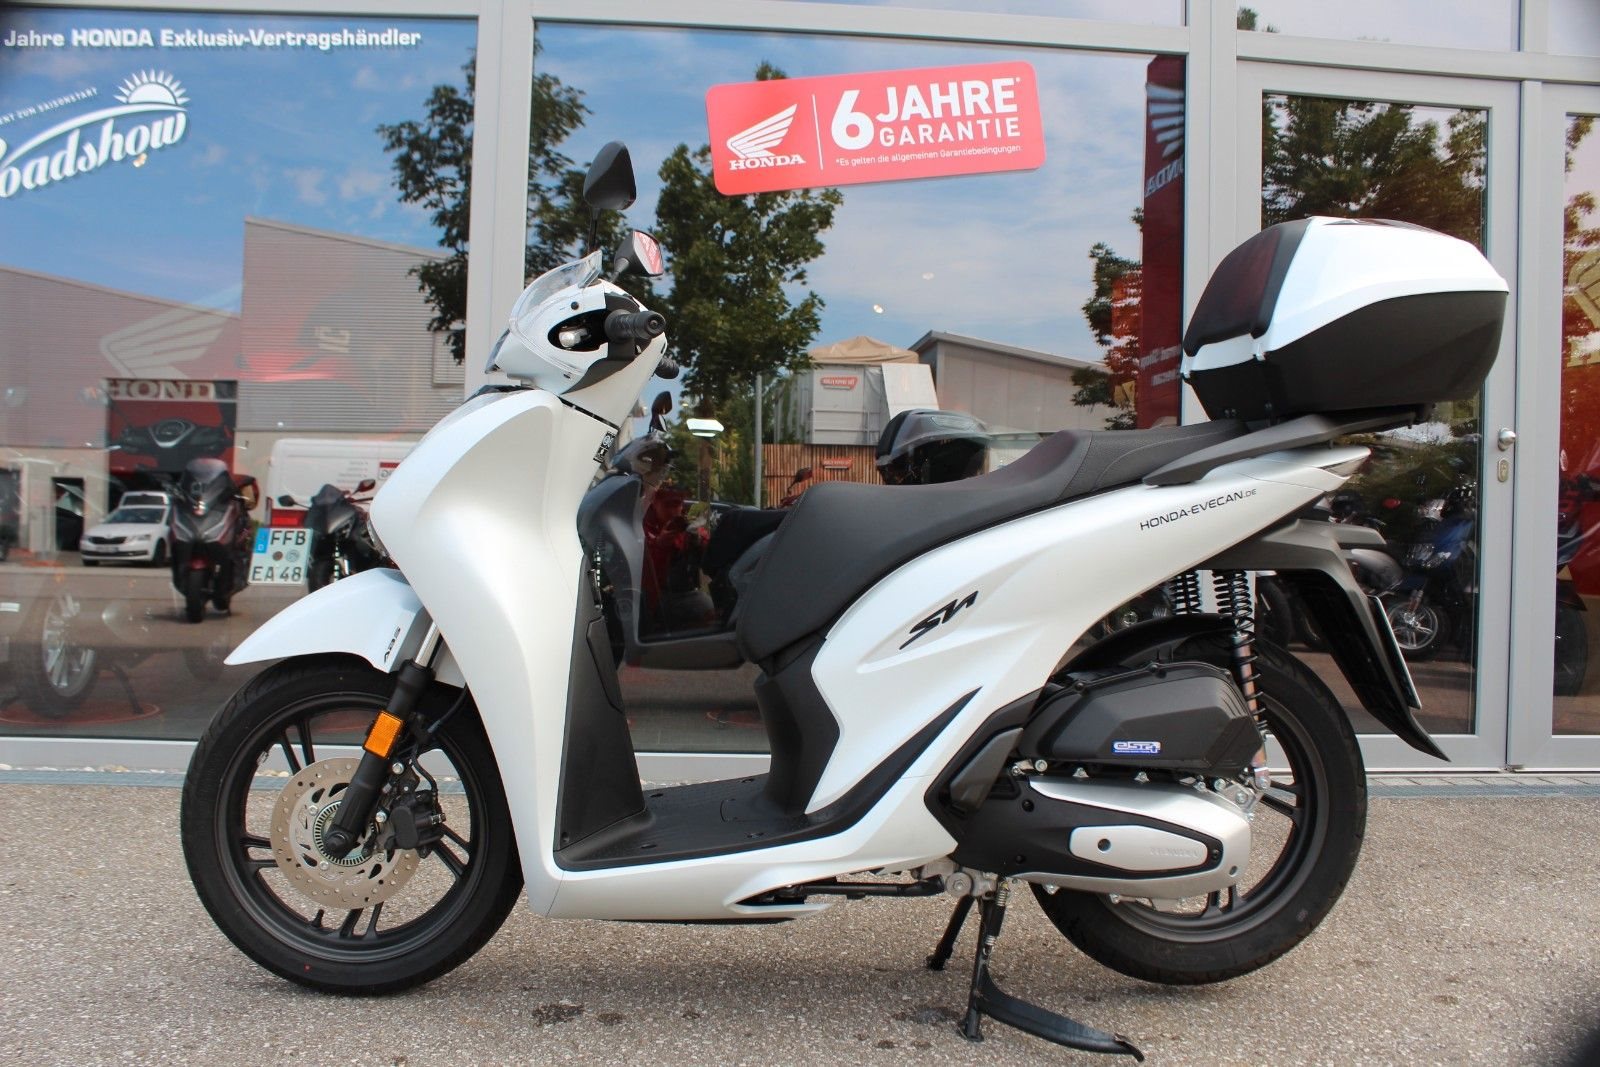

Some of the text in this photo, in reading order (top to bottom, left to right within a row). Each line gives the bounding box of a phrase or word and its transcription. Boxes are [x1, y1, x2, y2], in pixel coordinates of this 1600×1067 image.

[4, 28, 422, 51] Jahre HONDA Exklusiv-Vertragshändler
[831, 89, 875, 150] 6
[879, 117, 1021, 147] GARANTIE
[729, 153, 807, 171] HONDA
[851, 155, 876, 167] gelten
[877, 153, 890, 163] die
[891, 150, 939, 164] allgemeinen
[1139, 488, 1258, 531] HONDA-EVECAN.DE
[270, 530, 306, 546] FFB
